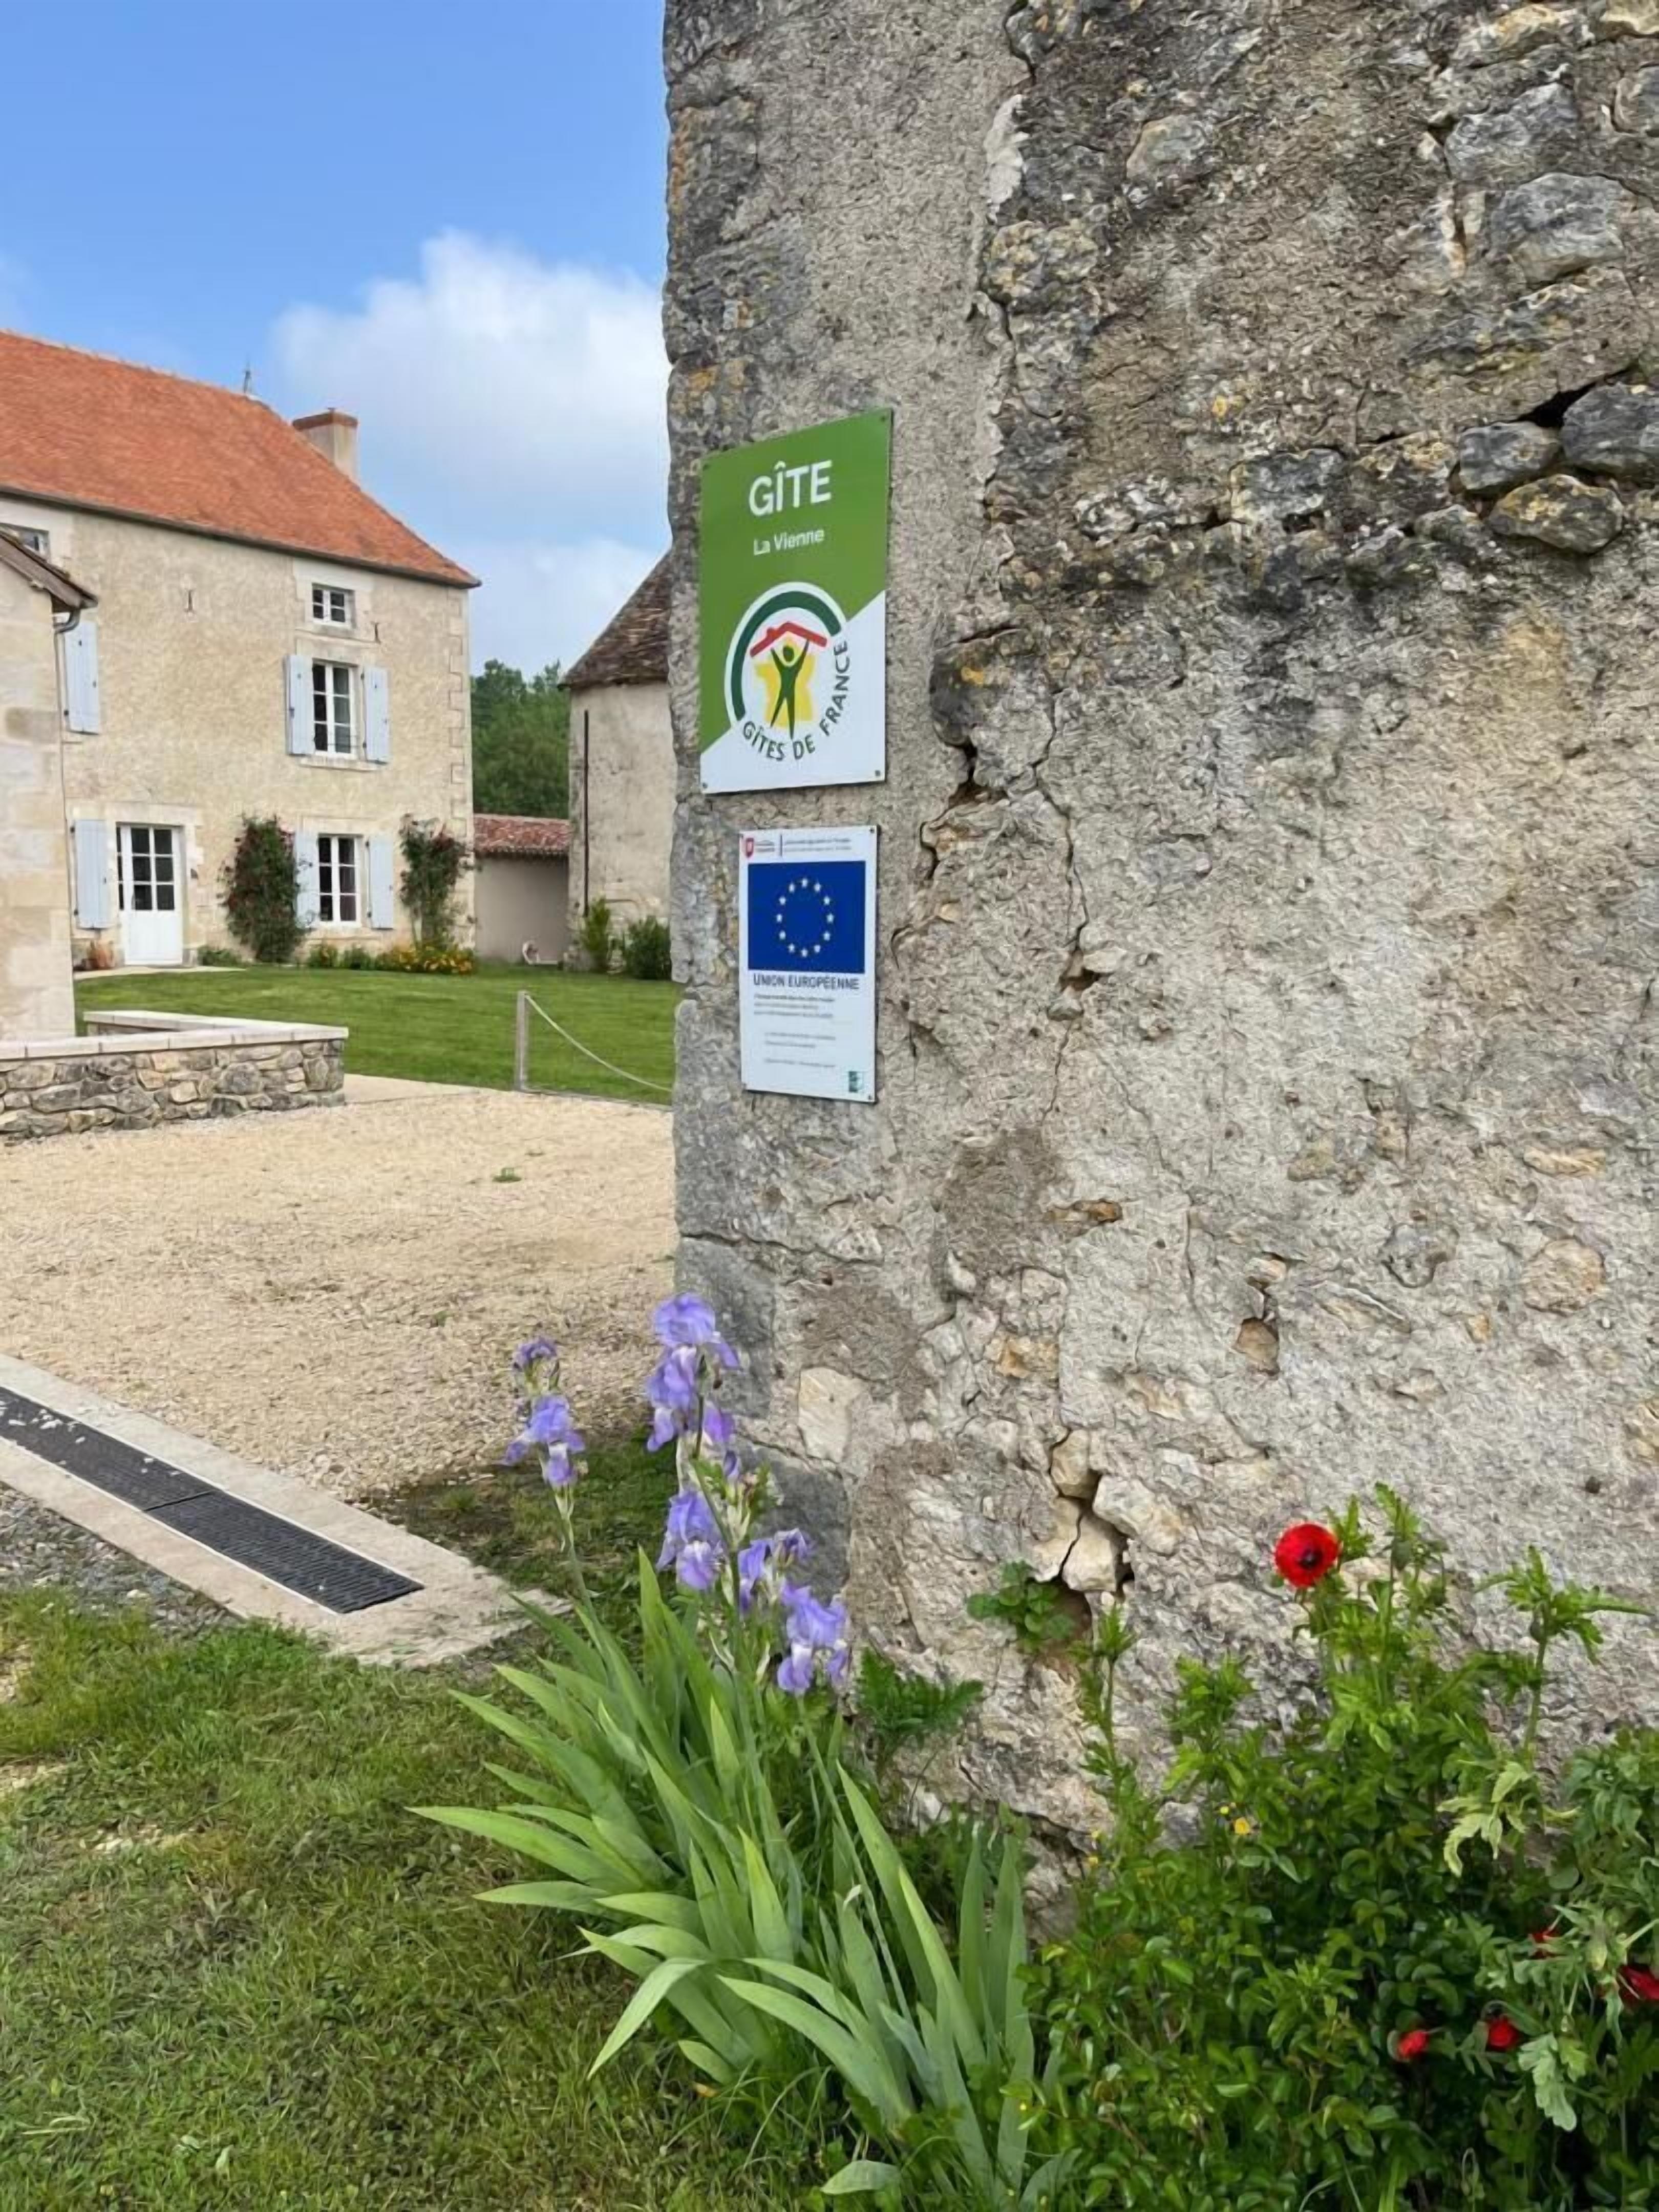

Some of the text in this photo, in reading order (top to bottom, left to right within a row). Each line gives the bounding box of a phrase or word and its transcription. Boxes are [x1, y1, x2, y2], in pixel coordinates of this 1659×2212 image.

[749, 460, 833, 516] GÎTE
[754, 529, 825, 556] La Vienne
[742, 640, 850, 761] GÎTES DE FRANCE
[754, 973, 784, 986] UNION
